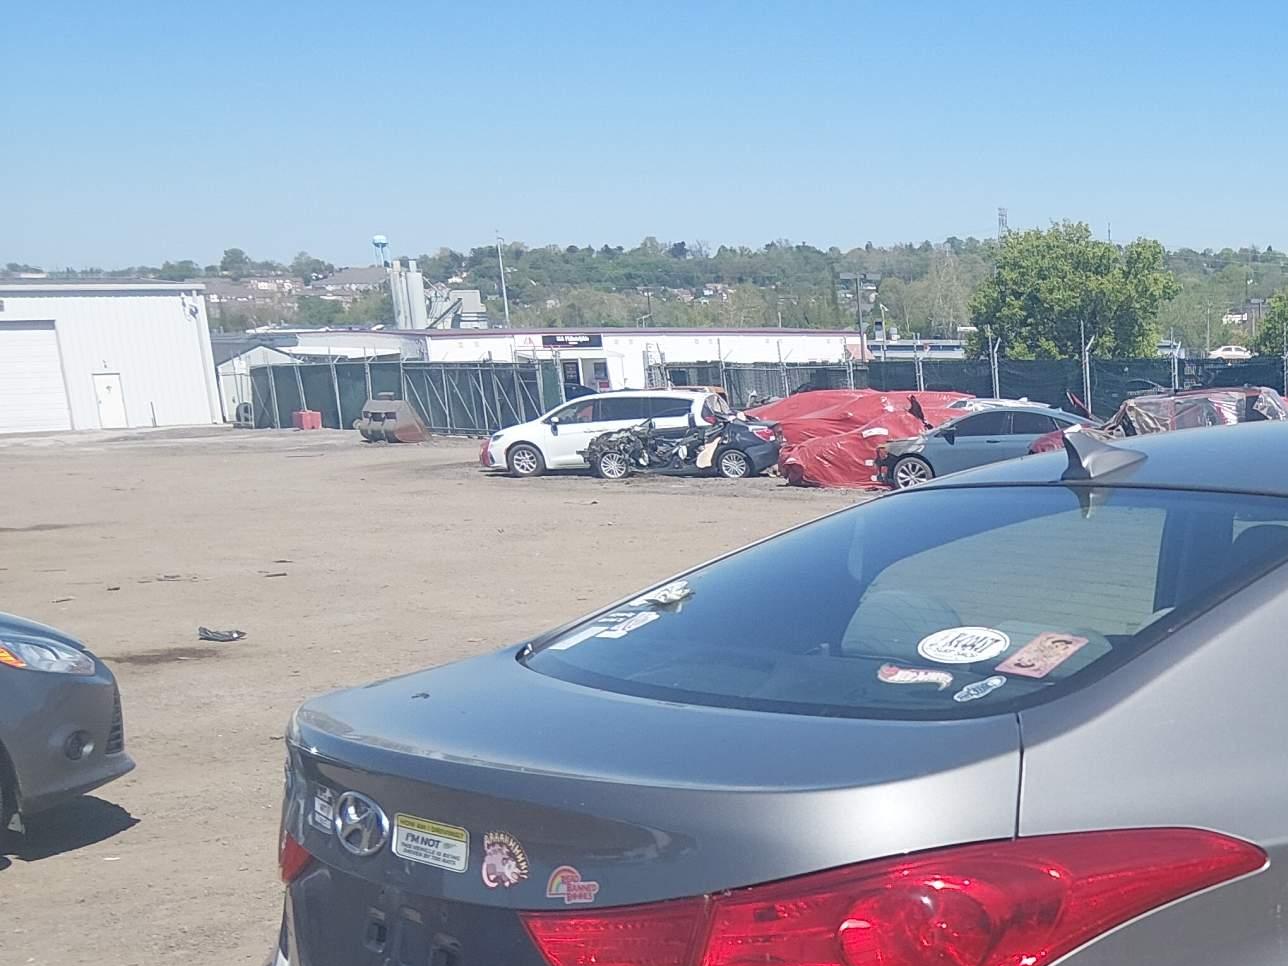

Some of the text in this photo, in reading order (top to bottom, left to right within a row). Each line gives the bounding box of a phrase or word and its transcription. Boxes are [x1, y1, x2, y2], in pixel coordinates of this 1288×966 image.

[405, 832, 441, 849] I'M NOT
[567, 883, 598, 892] BANNED
